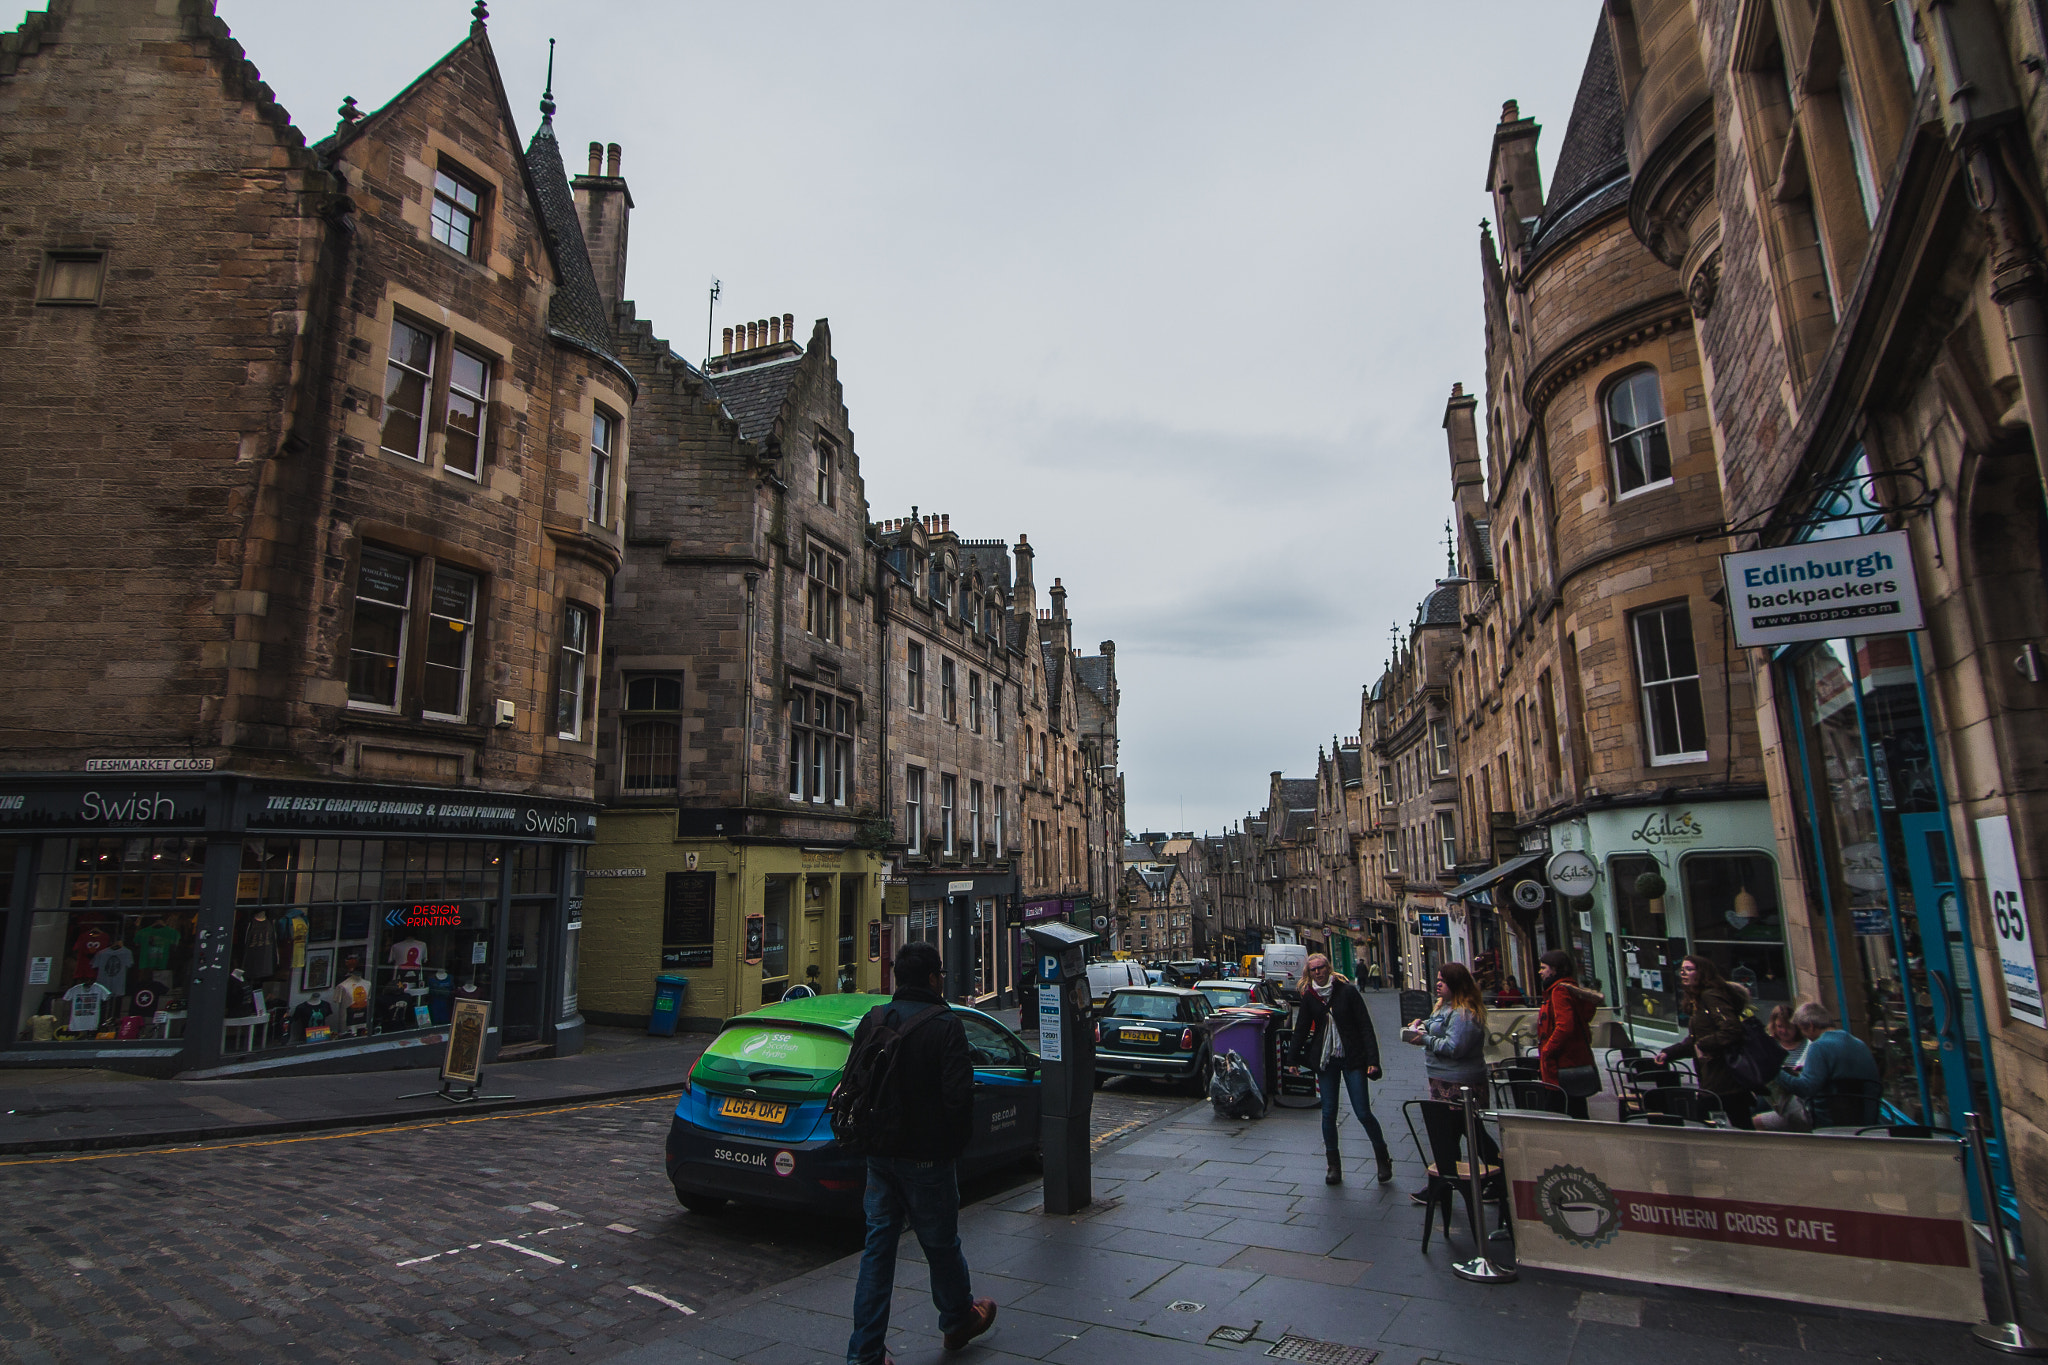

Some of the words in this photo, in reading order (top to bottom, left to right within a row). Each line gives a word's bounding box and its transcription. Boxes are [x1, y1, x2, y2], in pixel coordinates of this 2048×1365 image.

[1744, 551, 1893, 587] Edinburgh
[1748, 580, 1897, 609] backpackers
[1756, 604, 1893, 626] www.hoppo.com
[88, 760, 170, 770] FLESHMARKET
[173, 760, 211, 770] CLOSE
[80, 791, 175, 821] Swish
[267, 796, 293, 810] THE
[291, 797, 326, 811] BEST
[325, 798, 379, 813] GRAPHIC
[378, 801, 424, 816] BRANDS
[426, 804, 436, 816] &
[438, 804, 476, 818] DESIGN
[475, 806, 517, 820] PRINTING
[525, 809, 577, 834] Swish
[1631, 811, 1703, 845] Laila's
[621, 869, 645, 877] CLOSE
[1553, 865, 1593, 882] Laila's
[413, 905, 460, 915] DESIGN
[1994, 890, 2025, 941] 65
[406, 915, 462, 927] PRINTING
[1044, 955, 1057, 978] P
[772, 1033, 791, 1042] sse
[1042, 1031, 1058, 1039] 12001
[762, 1050, 786, 1059] Hydro
[767, 1041, 798, 1052] Scottish
[725, 1099, 756, 1116] LG64
[715, 1148, 767, 1167] sse.co.uk
[1541, 1189, 1554, 1217] ALWAYS
[1568, 1172, 1582, 1182] HOT
[1629, 1202, 1719, 1231] SOUTHERN
[1724, 1211, 1779, 1237] CROSS
[1784, 1218, 1838, 1243] CAFE
